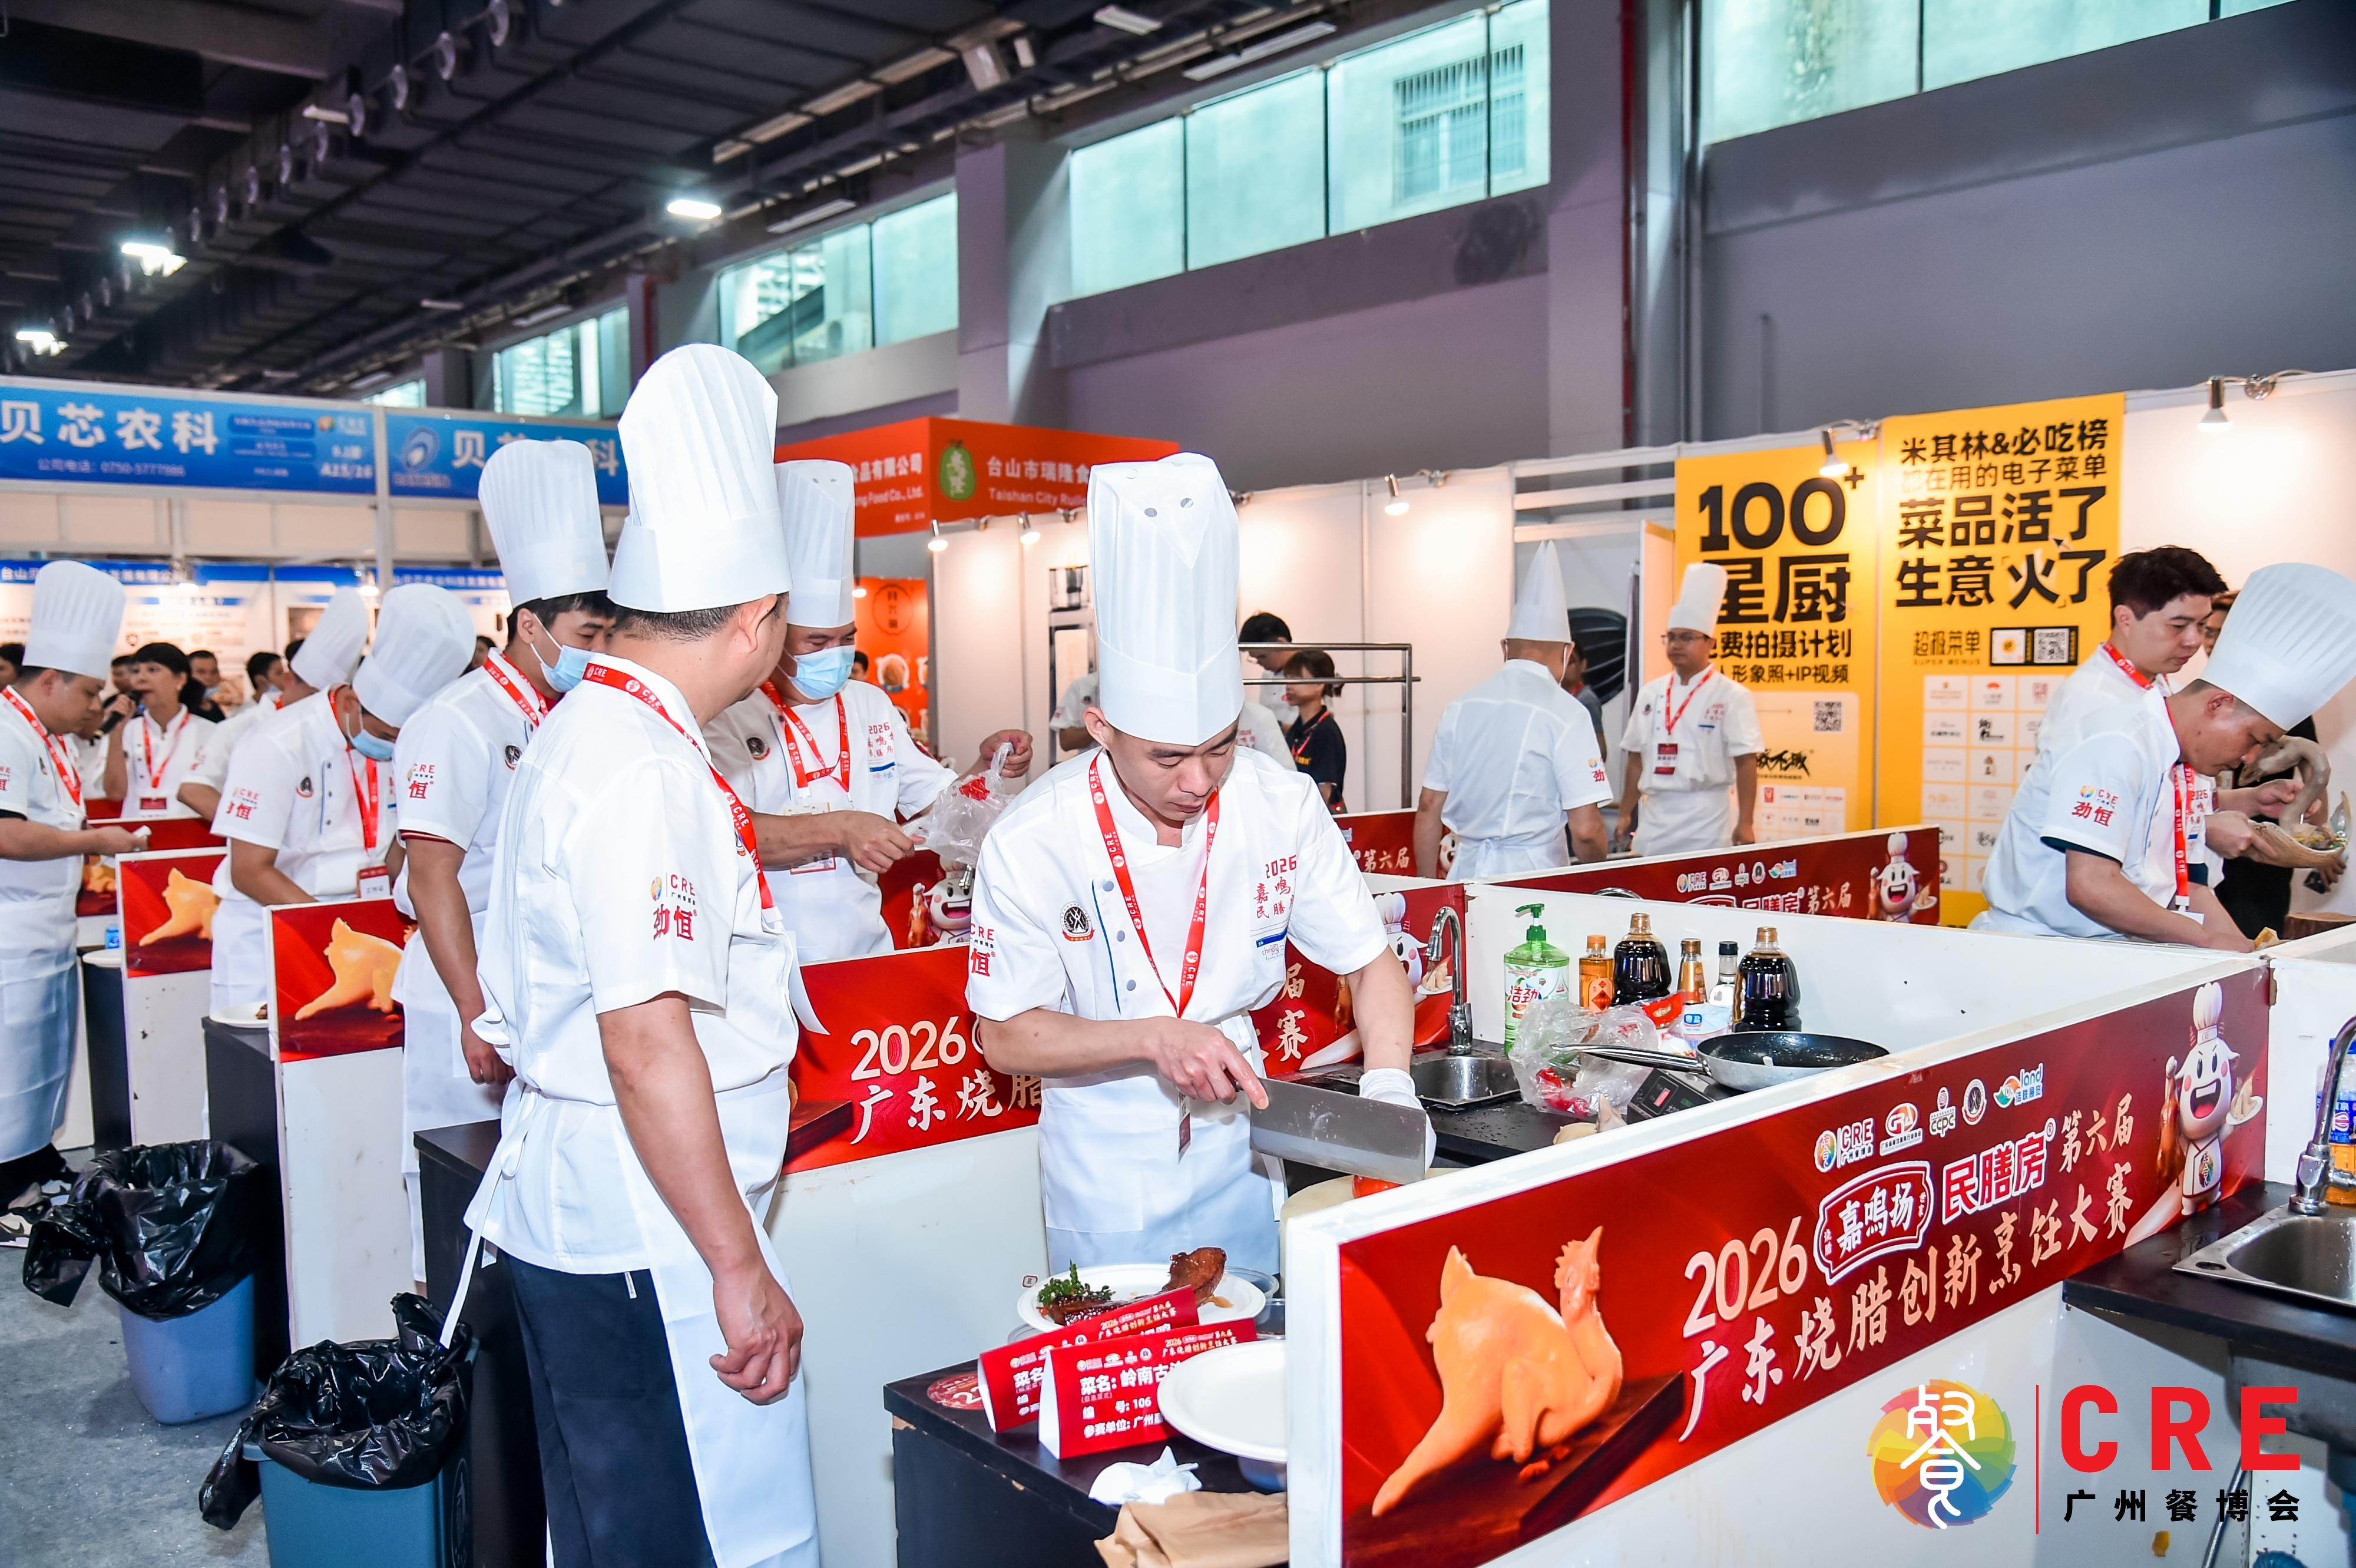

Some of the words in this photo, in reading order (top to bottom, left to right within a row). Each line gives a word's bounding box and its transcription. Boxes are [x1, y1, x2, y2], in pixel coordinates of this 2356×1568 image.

[1, 401, 220, 456] 贝芯农科
[452, 430, 618, 478] 贝科
[1901, 419, 2109, 466] 米其林&必吃榜
[989, 488, 1034, 503] Taishan
[1038, 491, 1057, 507] City
[1898, 486, 2107, 549] 菜品活了
[1702, 554, 1851, 624] 星厨
[594, 667, 607, 677] CRE
[642, 689, 663, 709] CRE
[1089, 768, 1098, 790] CRE
[733, 805, 750, 828] CRE
[2072, 801, 2113, 827] 劲恒
[1104, 832, 1117, 854] CRE
[1266, 855, 1296, 879] 2026
[1364, 847, 1409, 873] 第六届
[670, 874, 696, 897] CRE
[1807, 881, 1852, 914] 第六届
[1124, 895, 1137, 915] CRE
[1196, 902, 1205, 923] CRE
[653, 904, 694, 941] 劲恒
[970, 923, 995, 941] CRE
[1184, 967, 1196, 987] CRE
[1507, 985, 1539, 1004] 洁劲
[1685, 1014, 1701, 1024] 粤盐
[850, 1016, 967, 1081] 2026
[1842, 1120, 1872, 1150] CRE
[2059, 1093, 2133, 1173] 第六届
[1683, 1215, 1808, 1339] 2026
[1679, 1161, 2134, 1443] 广东烧腊创新烹饪大赛
